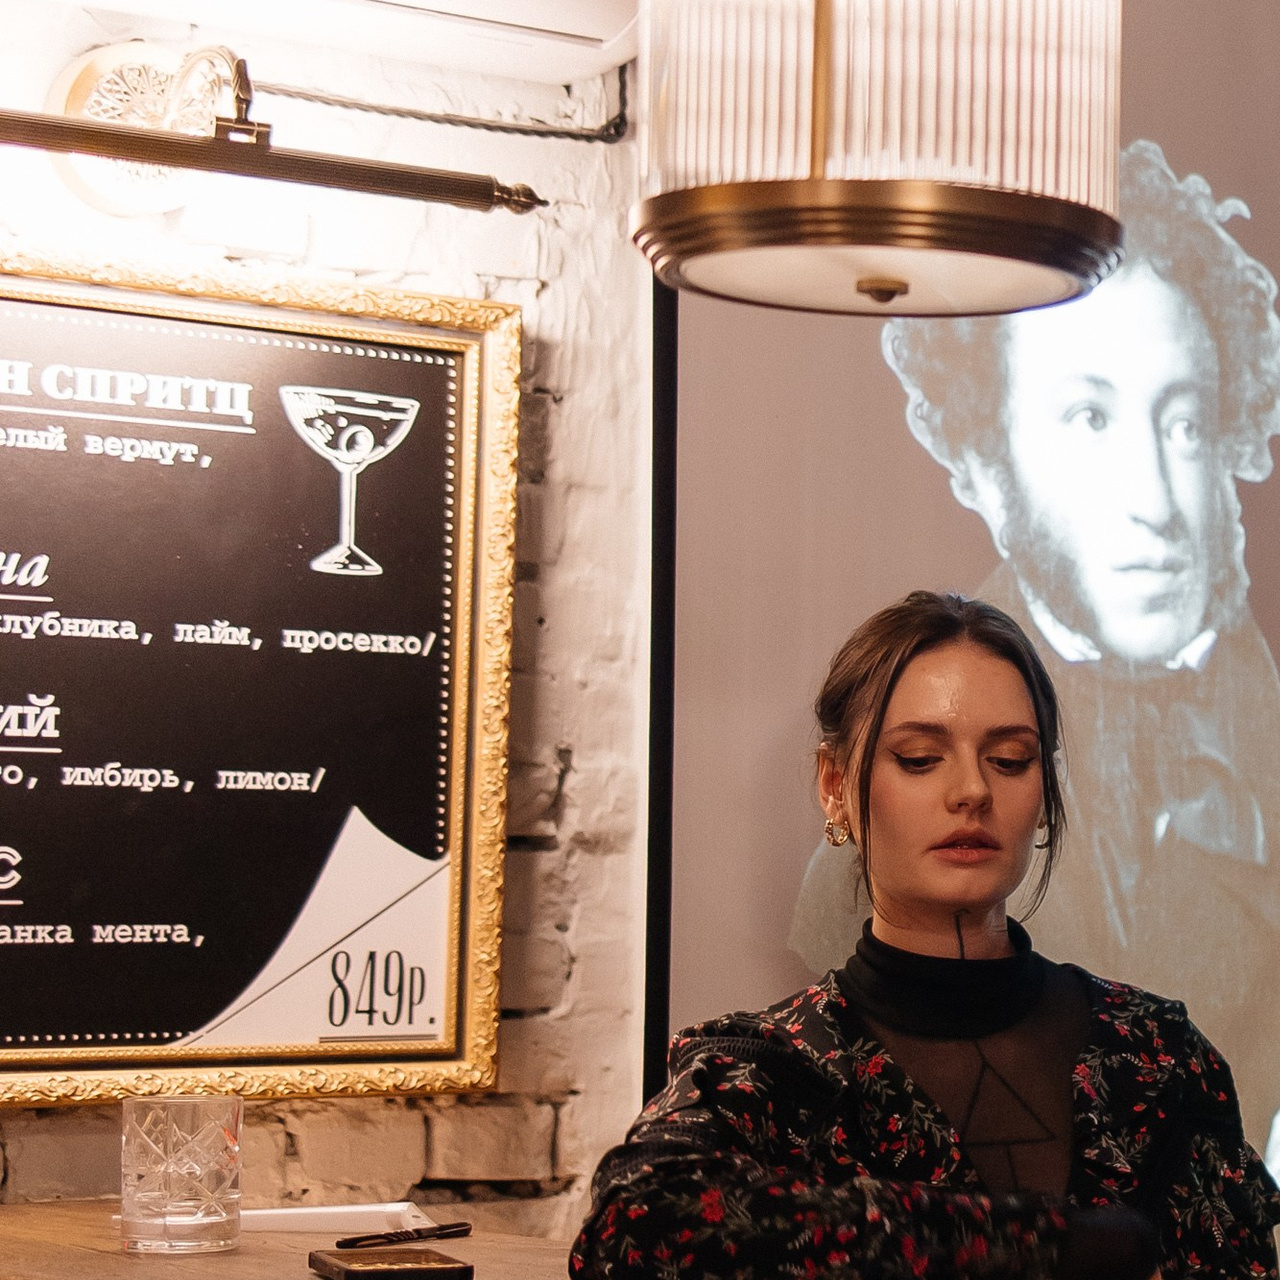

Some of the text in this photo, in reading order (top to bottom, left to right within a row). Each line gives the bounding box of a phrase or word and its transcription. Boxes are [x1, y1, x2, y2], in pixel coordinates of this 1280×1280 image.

[41, 364, 254, 425] СПРИТЦ
[83, 433, 213, 468] вермут,
[0, 611, 436, 657] лубника, лайм, просекко/
[61, 761, 195, 793] имбирь,
[216, 767, 326, 793] лимон/
[92, 924, 205, 947] мента,
